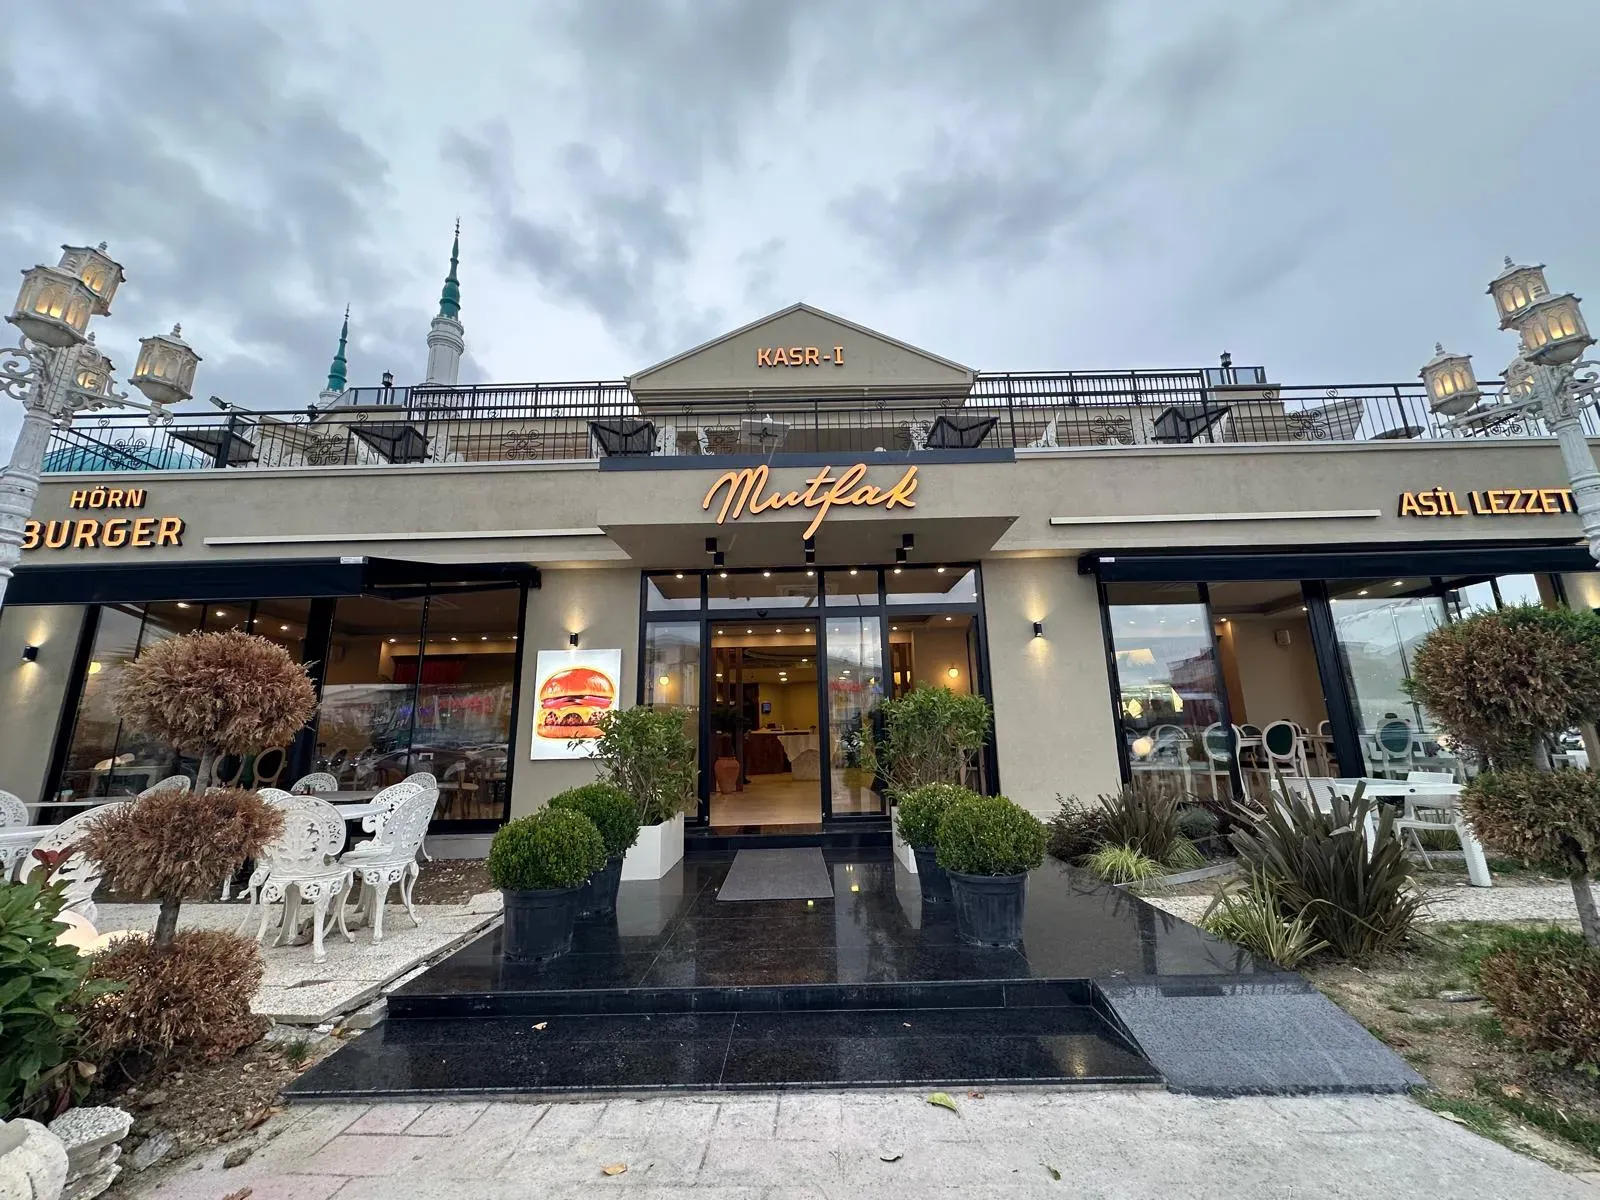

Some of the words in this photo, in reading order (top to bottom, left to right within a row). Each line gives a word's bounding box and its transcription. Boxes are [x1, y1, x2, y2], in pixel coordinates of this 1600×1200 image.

[757, 346, 844, 367] KASR-I
[69, 485, 147, 510] HÖRN
[703, 463, 918, 540] Mutfak
[1399, 486, 1469, 516] ASİL
[1469, 488, 1574, 515] LEZZET
[21, 517, 185, 549] BURGER
